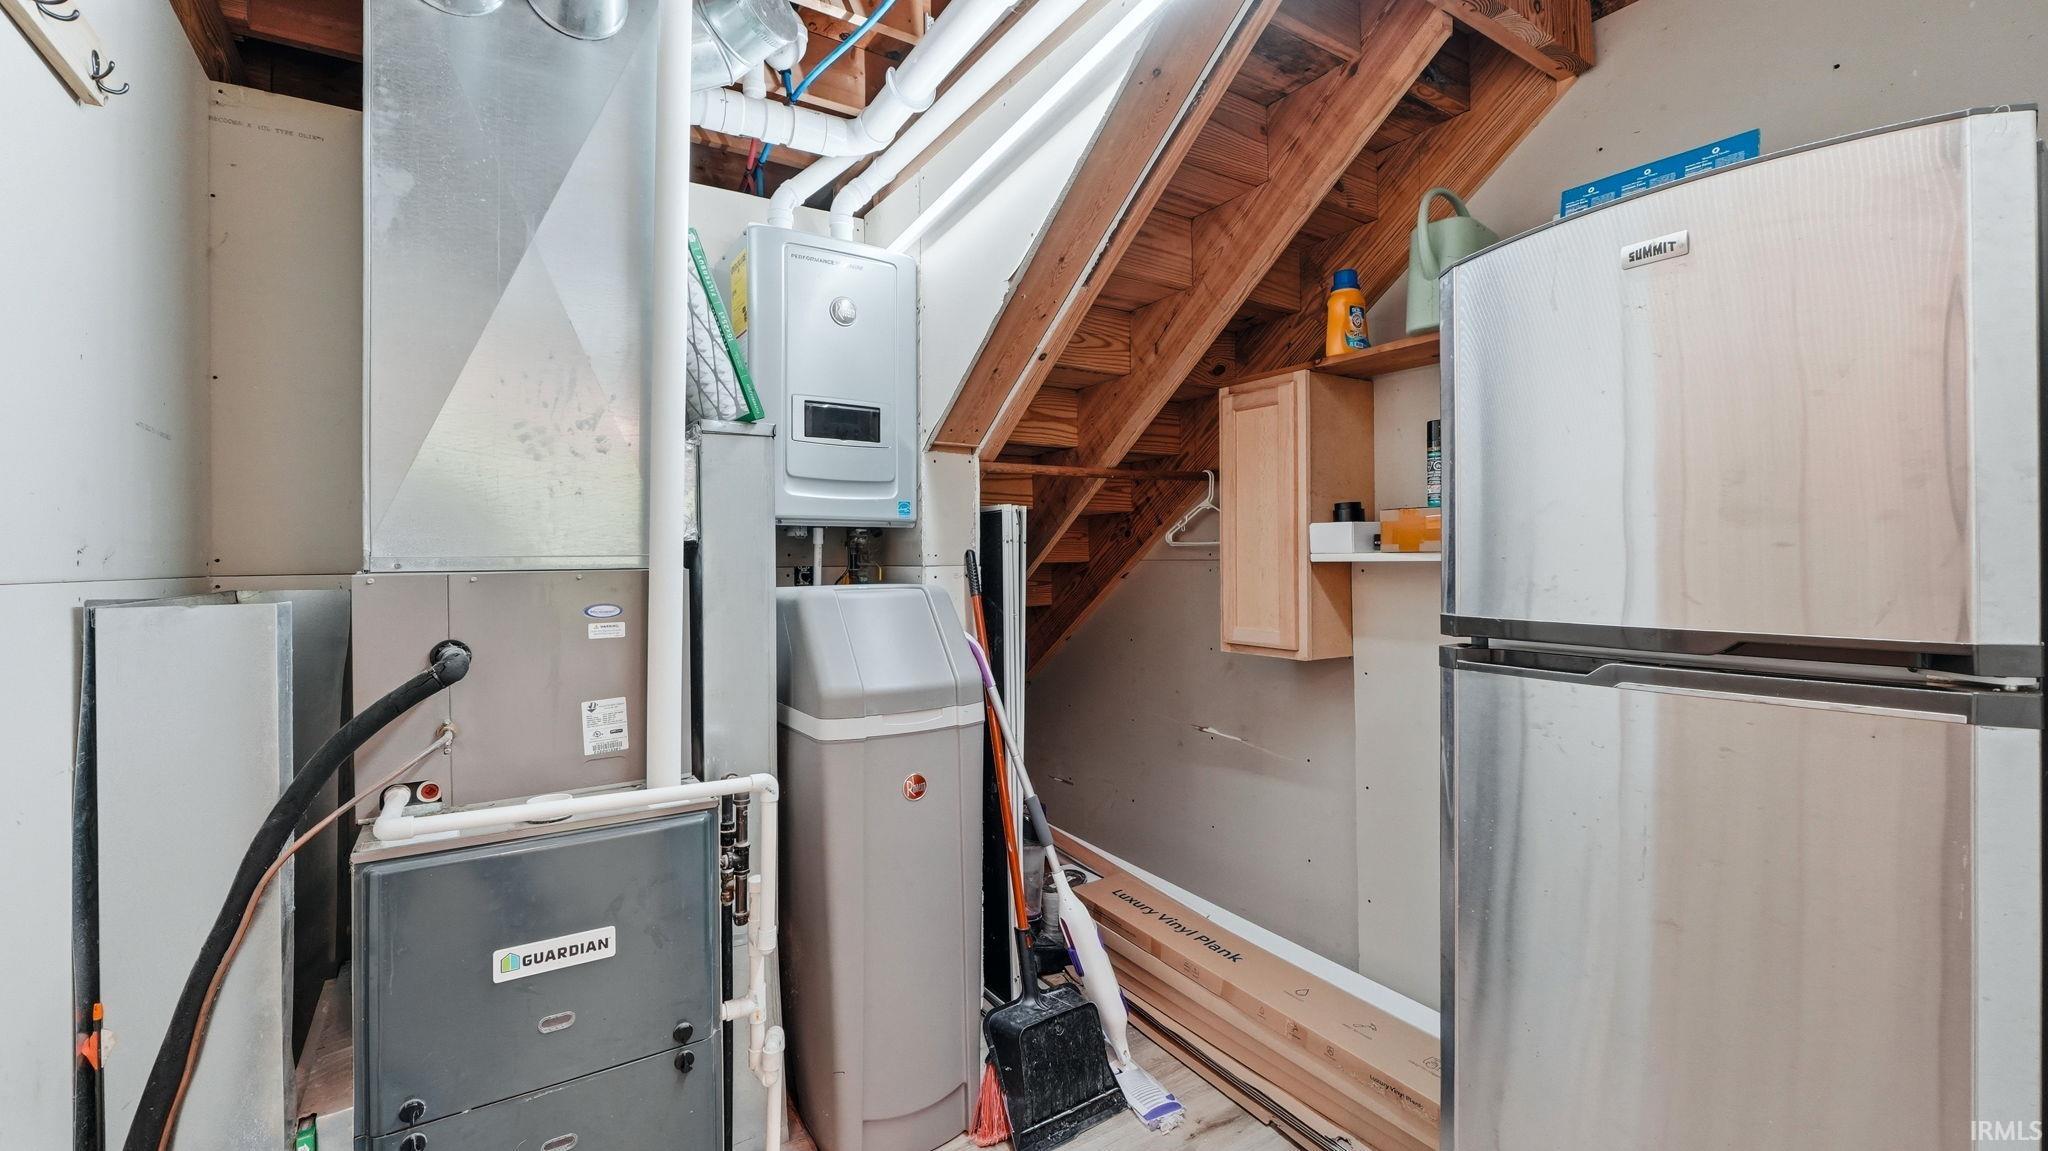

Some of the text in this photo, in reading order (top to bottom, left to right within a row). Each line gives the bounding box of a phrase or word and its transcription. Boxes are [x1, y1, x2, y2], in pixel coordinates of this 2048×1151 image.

[1628, 241, 1676, 262] SUMMIT
[1112, 889, 1243, 963] Luxury Vinyl Plank
[522, 938, 609, 966] GUARDIAN
